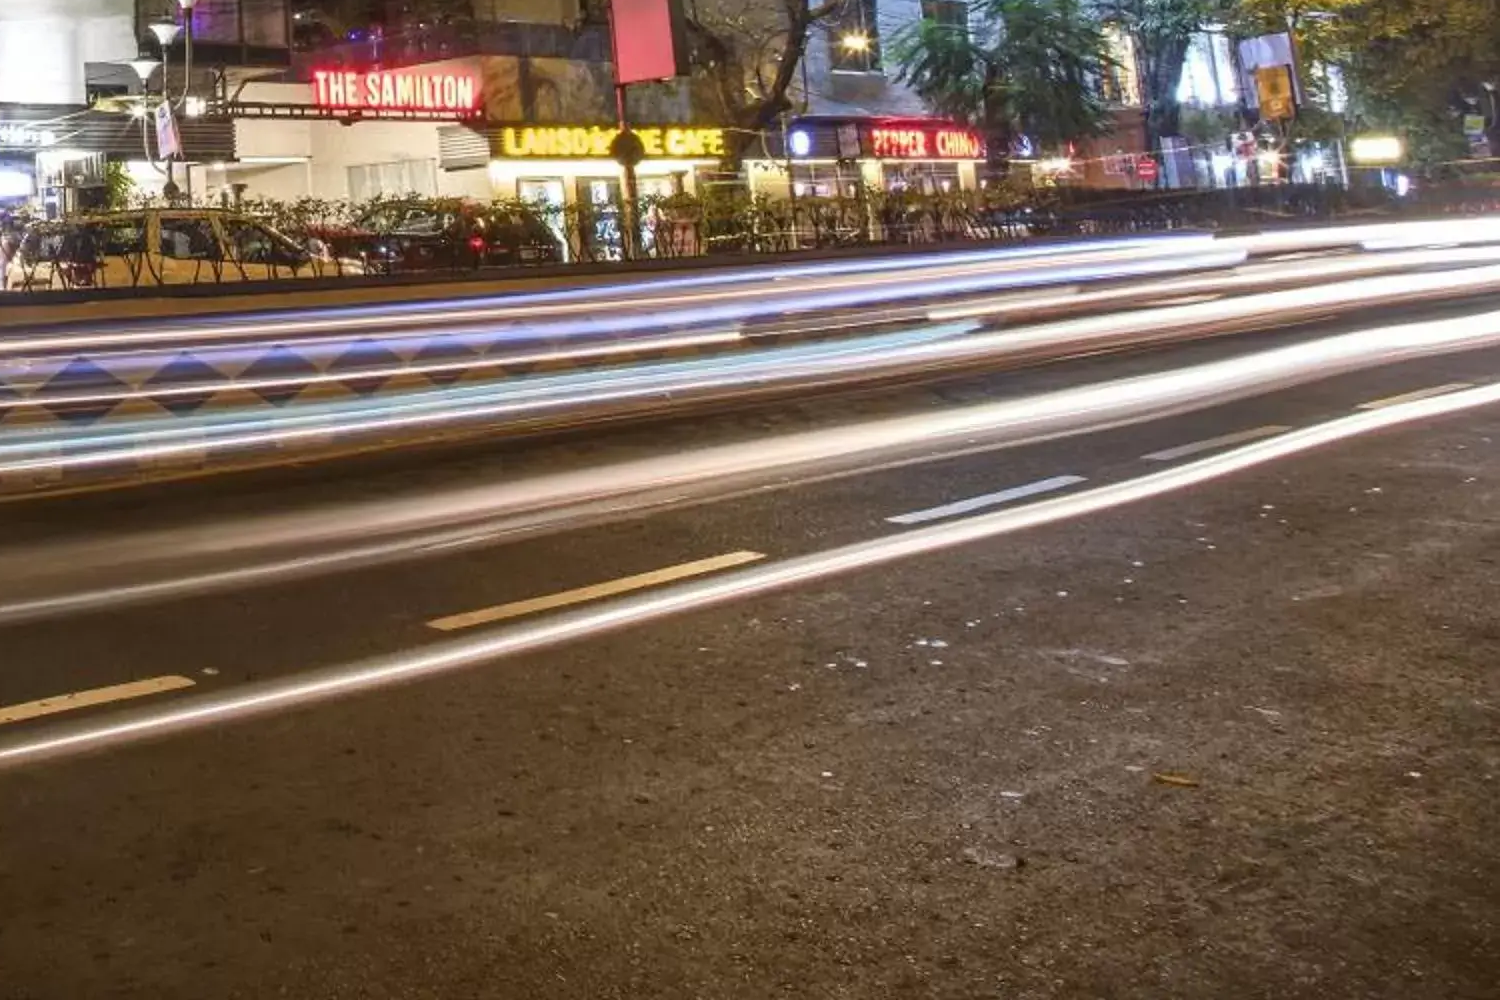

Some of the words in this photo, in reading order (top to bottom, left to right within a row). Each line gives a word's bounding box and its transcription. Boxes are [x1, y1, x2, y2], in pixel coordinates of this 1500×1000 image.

[314, 71, 358, 107] THE
[366, 72, 473, 109] SAMILTON
[666, 128, 724, 156] CAFE
